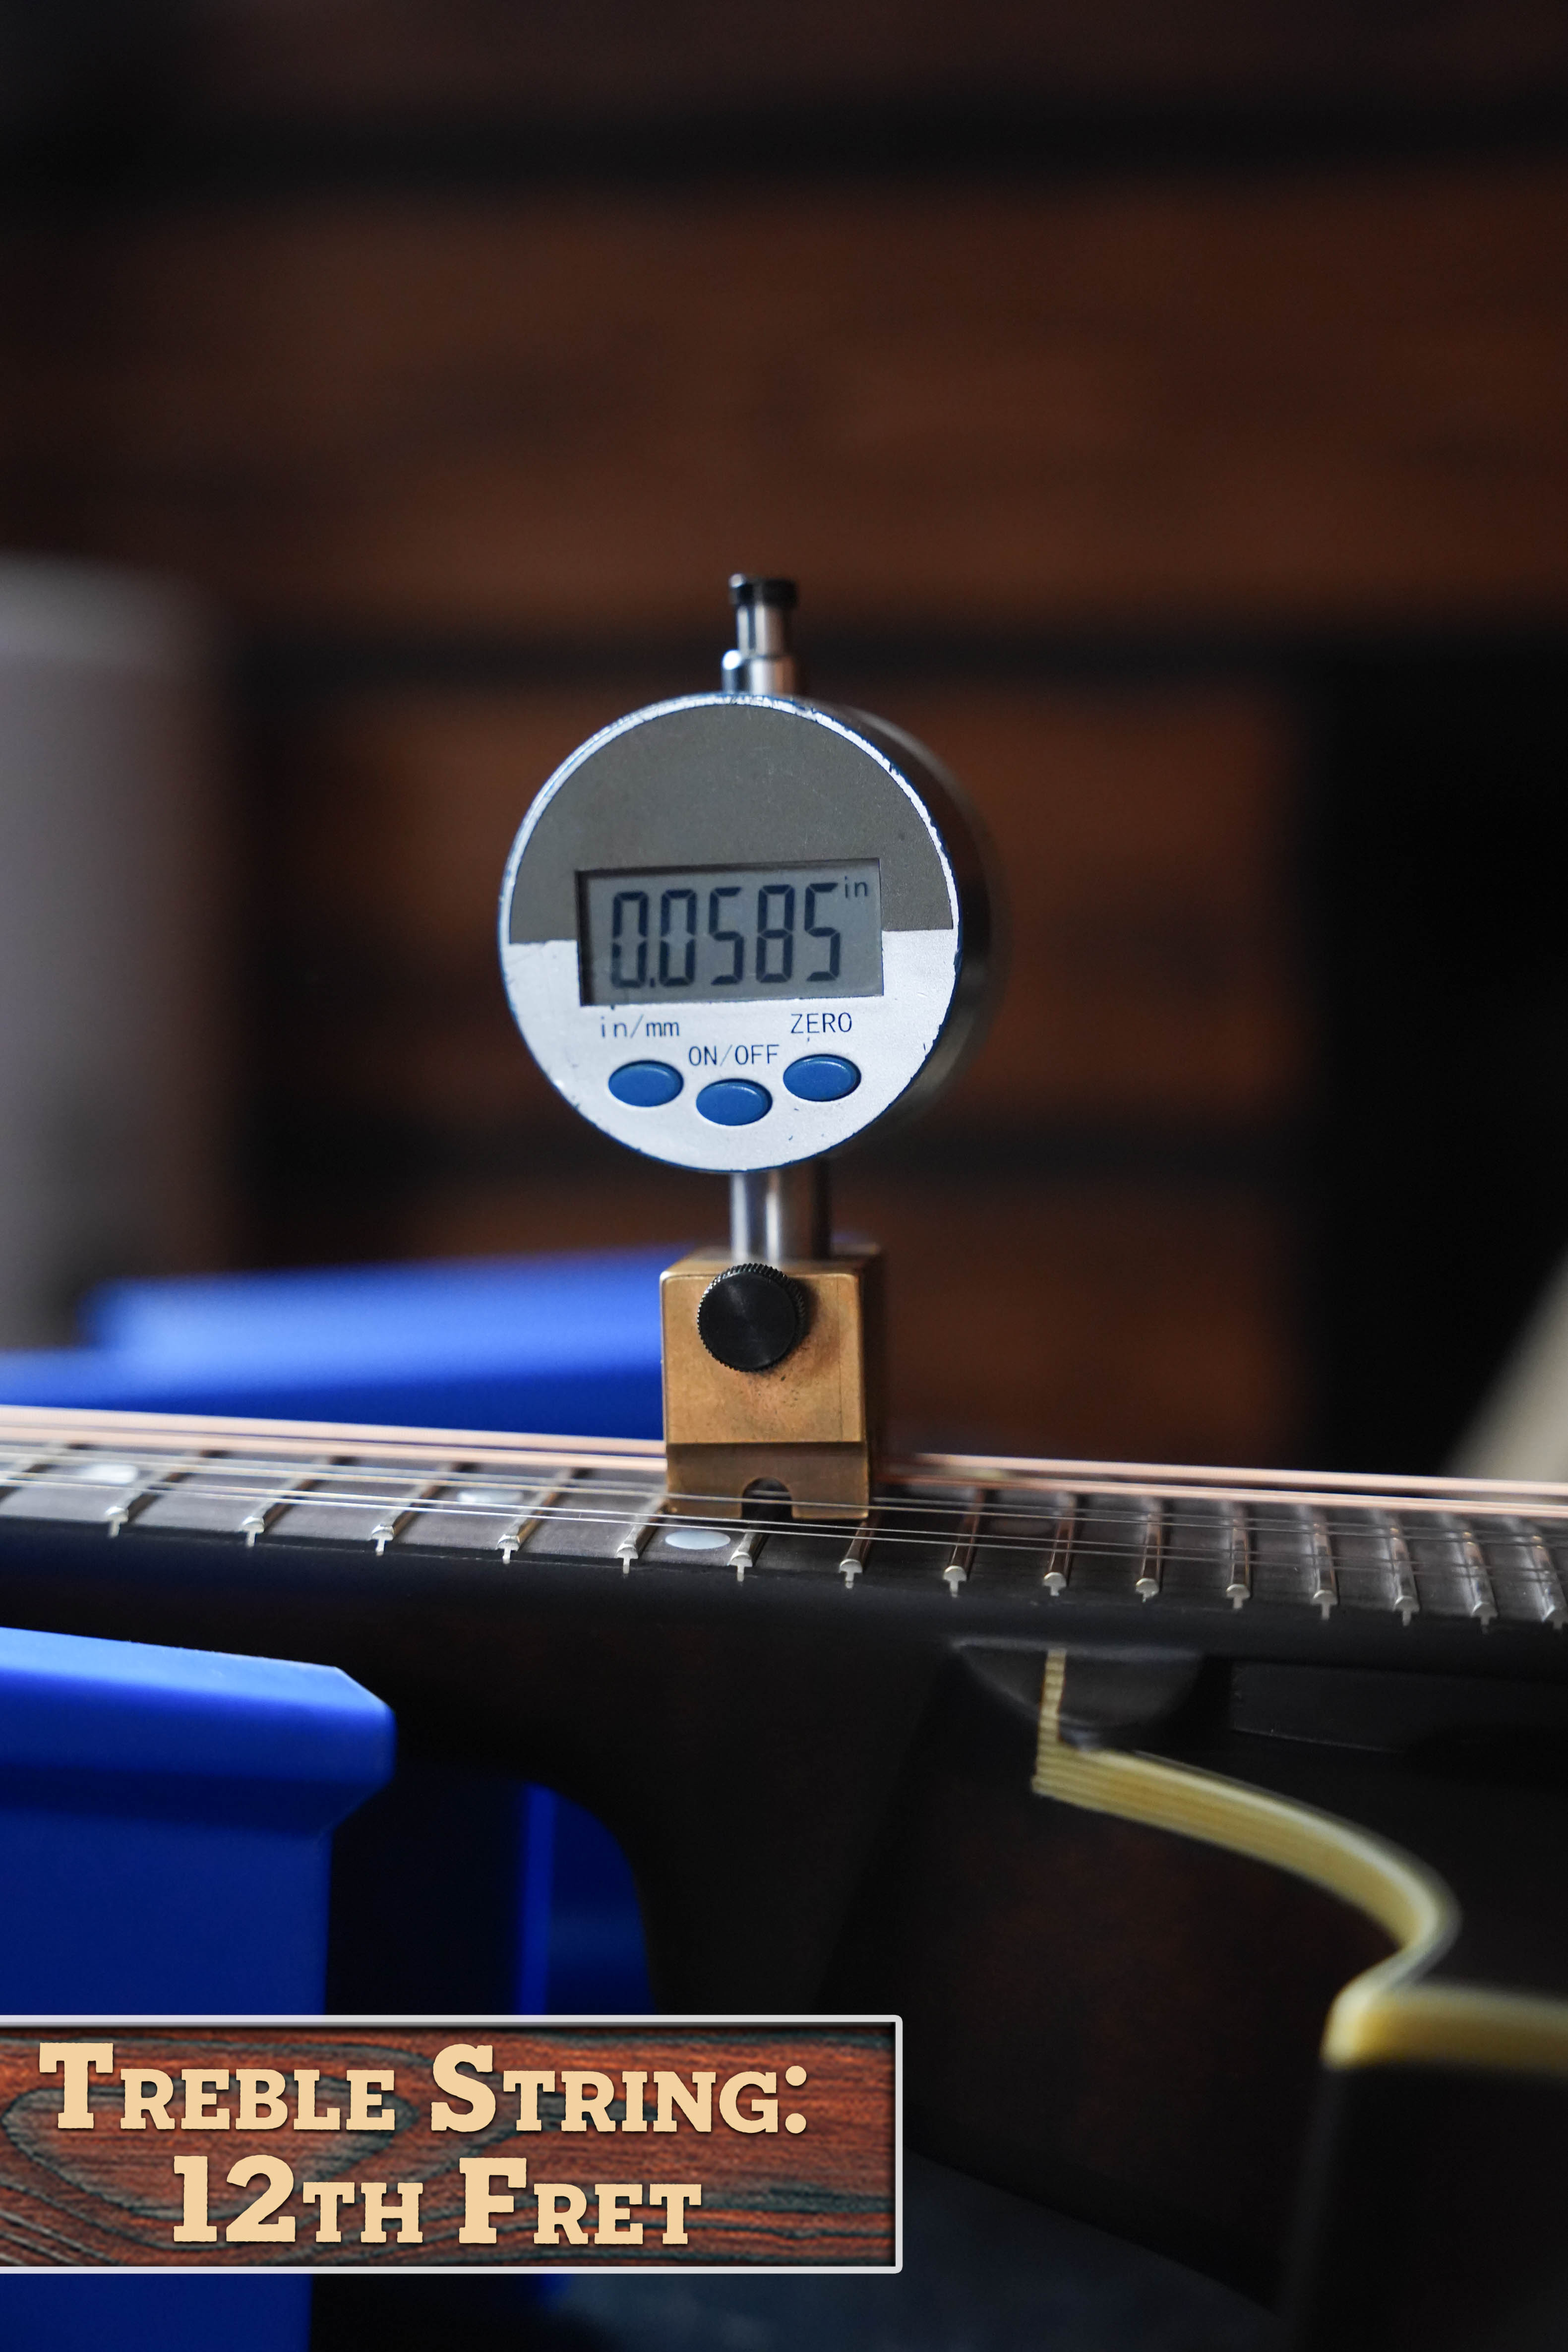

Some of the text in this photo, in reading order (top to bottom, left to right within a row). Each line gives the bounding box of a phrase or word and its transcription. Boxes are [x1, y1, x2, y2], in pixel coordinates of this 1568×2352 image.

[611, 876, 868, 988] 0.0585 in
[601, 1015, 680, 1038] in/mm
[791, 1013, 852, 1034] ZERO
[689, 1043, 780, 1066] ON/OFF
